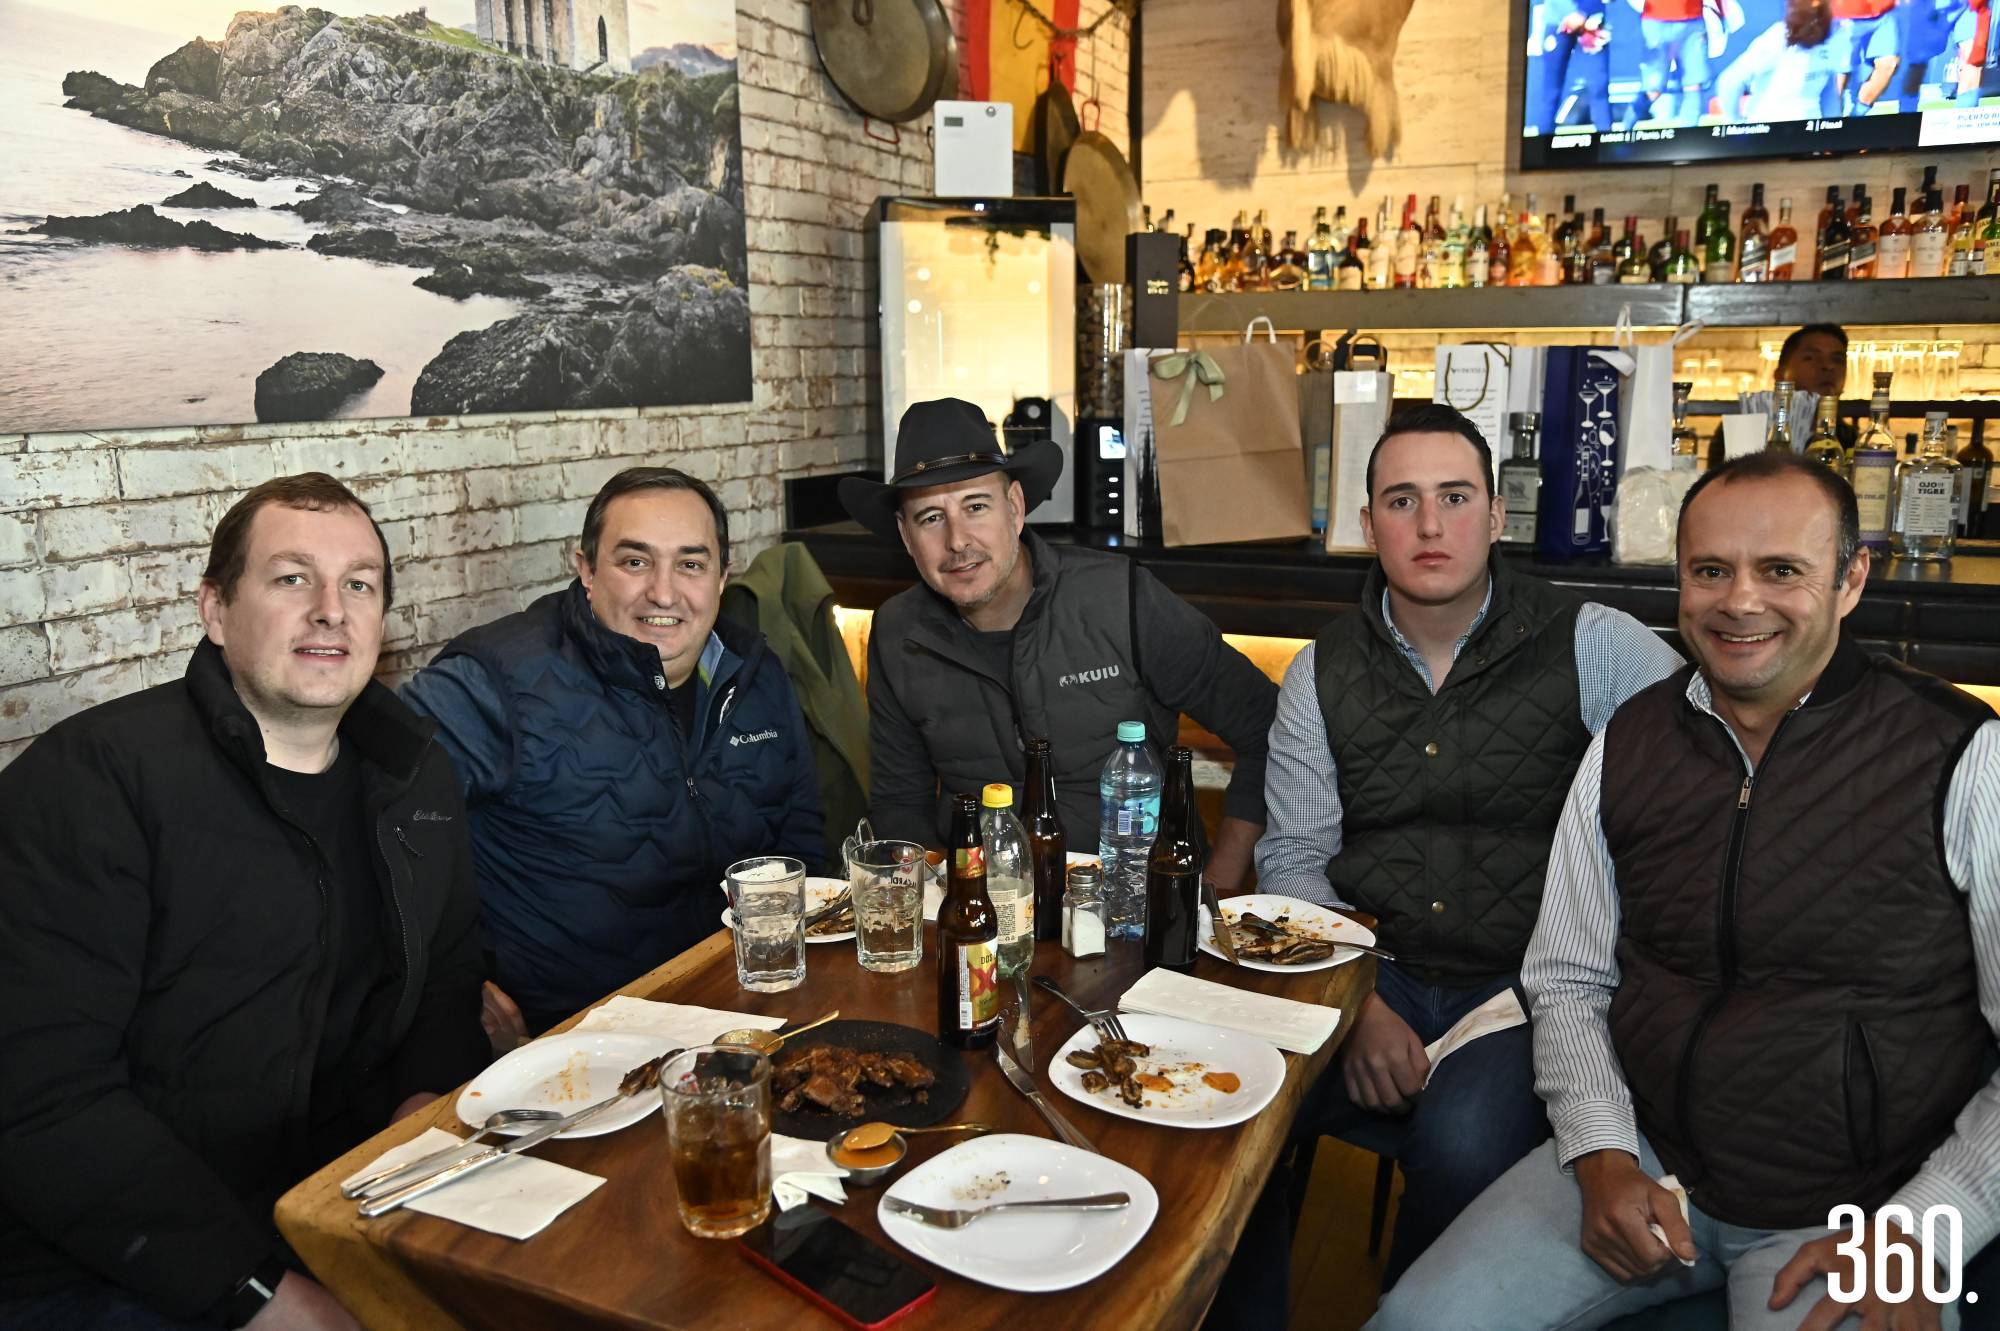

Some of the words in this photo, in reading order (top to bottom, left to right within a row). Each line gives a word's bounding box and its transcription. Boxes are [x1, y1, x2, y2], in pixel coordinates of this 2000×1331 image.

[1078, 664, 1120, 684] KUIU
[739, 729, 778, 744] Columbia
[980, 954, 993, 966] DOS
